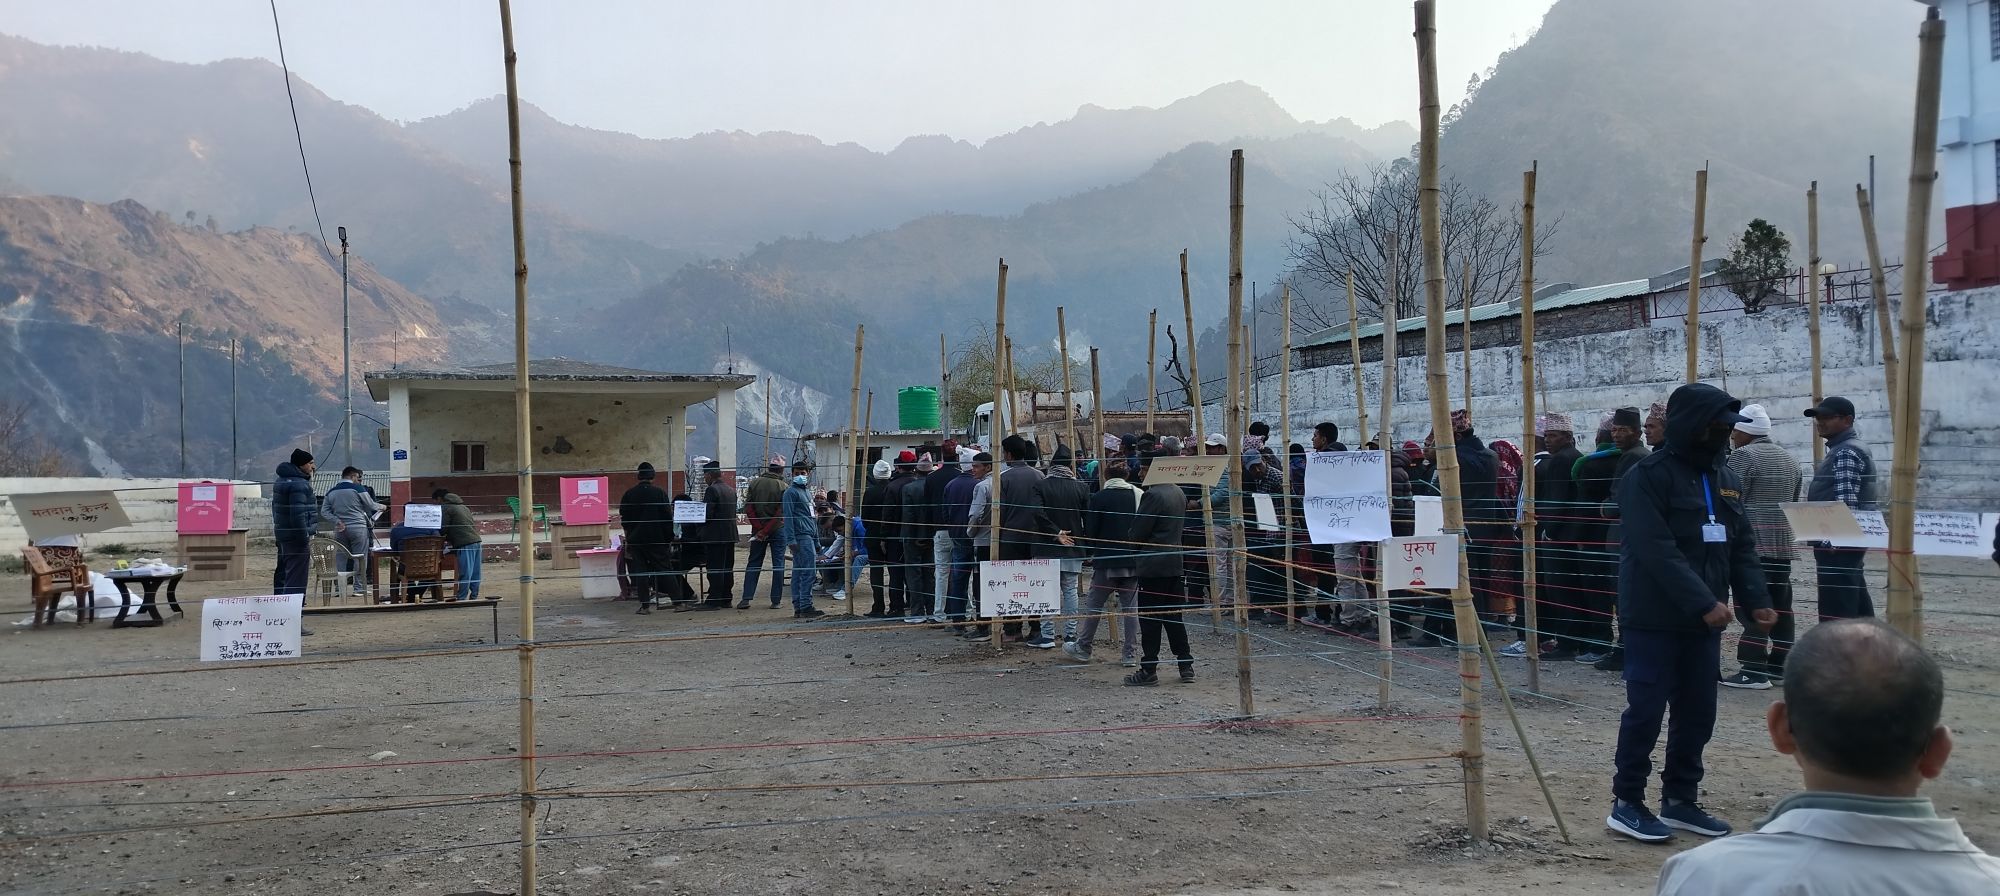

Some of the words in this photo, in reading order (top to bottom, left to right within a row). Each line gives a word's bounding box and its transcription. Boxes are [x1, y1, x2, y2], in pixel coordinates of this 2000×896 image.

[29, 506, 73, 517] मतदान
[1403, 542, 1437, 562] पुरुष
[1012, 591, 1029, 599] सम्म
[244, 612, 261, 622] देखि
[242, 632, 263, 641] सम्म
